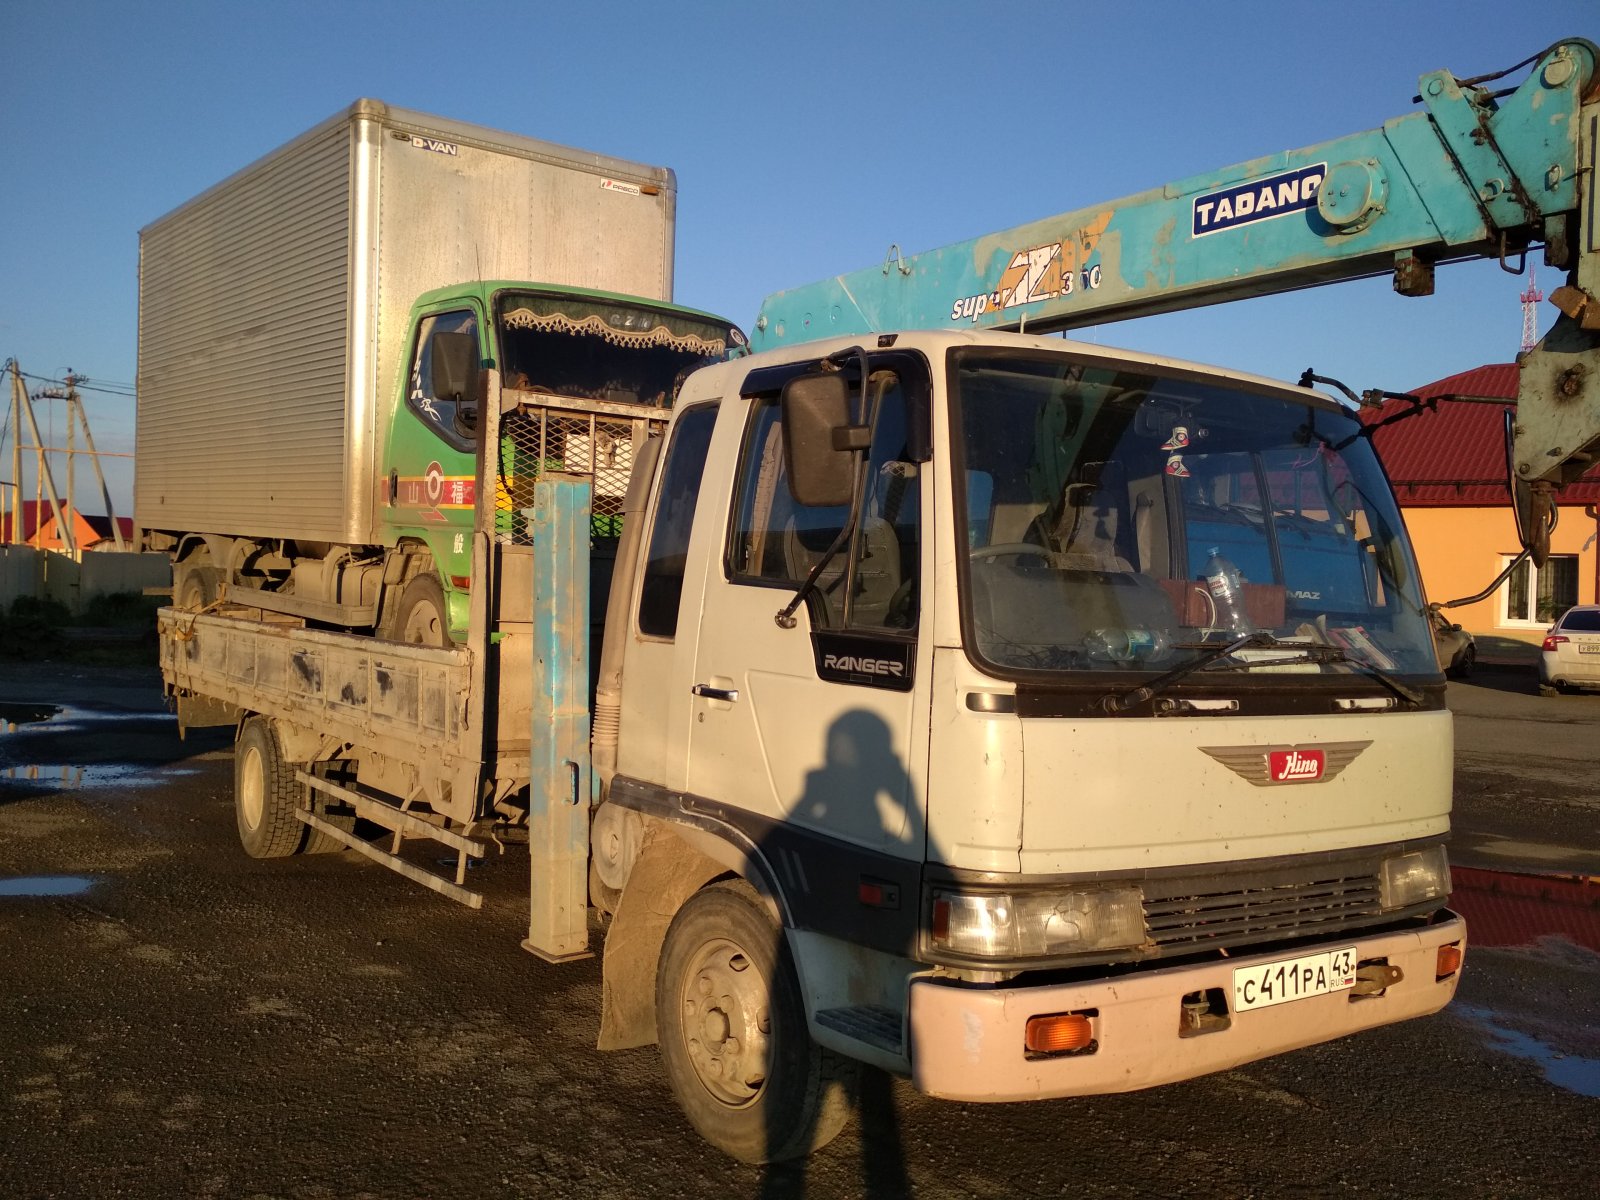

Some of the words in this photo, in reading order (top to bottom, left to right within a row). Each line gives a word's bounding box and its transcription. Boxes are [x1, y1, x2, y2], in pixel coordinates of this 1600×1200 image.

[1197, 174, 1322, 226] TADANO
[824, 654, 904, 677] RANGER
[1278, 751, 1318, 780] Hino
[1332, 952, 1351, 977] 43
[1330, 978, 1345, 988] RUS
